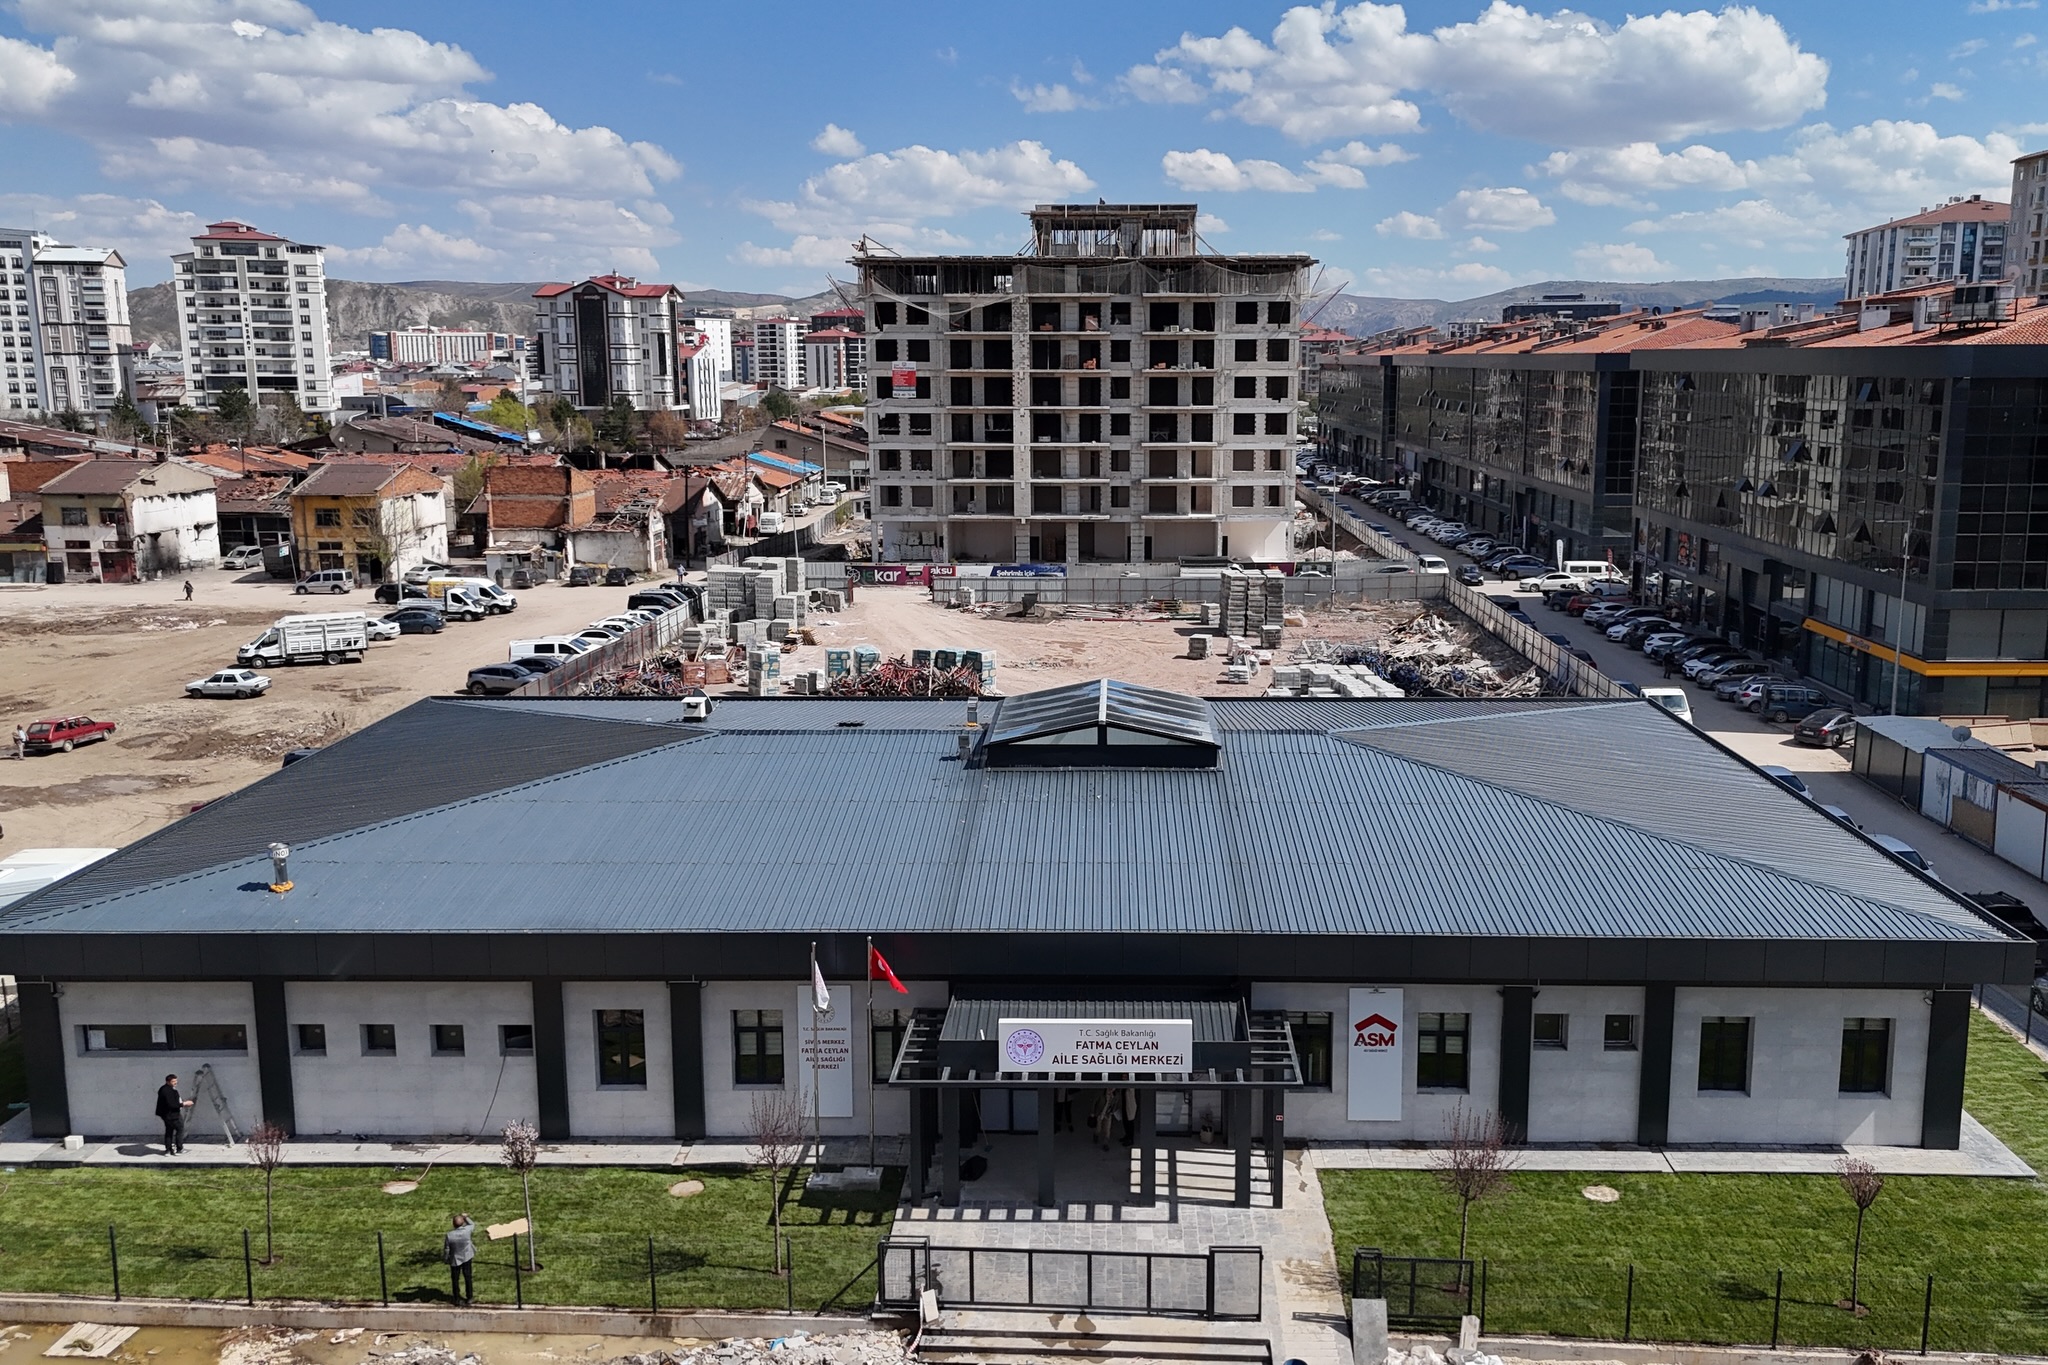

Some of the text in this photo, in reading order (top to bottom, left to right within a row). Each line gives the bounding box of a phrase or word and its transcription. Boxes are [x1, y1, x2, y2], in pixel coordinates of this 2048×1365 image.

[1079, 1029, 1157, 1039] T.C. Sağlık Bakanlığı
[1353, 1032, 1395, 1047] ASM
[1075, 1041, 1159, 1050] FATMA CEYLAN
[1051, 1052, 1183, 1065] AİLE SAĞLIĞI MERKEZİ
